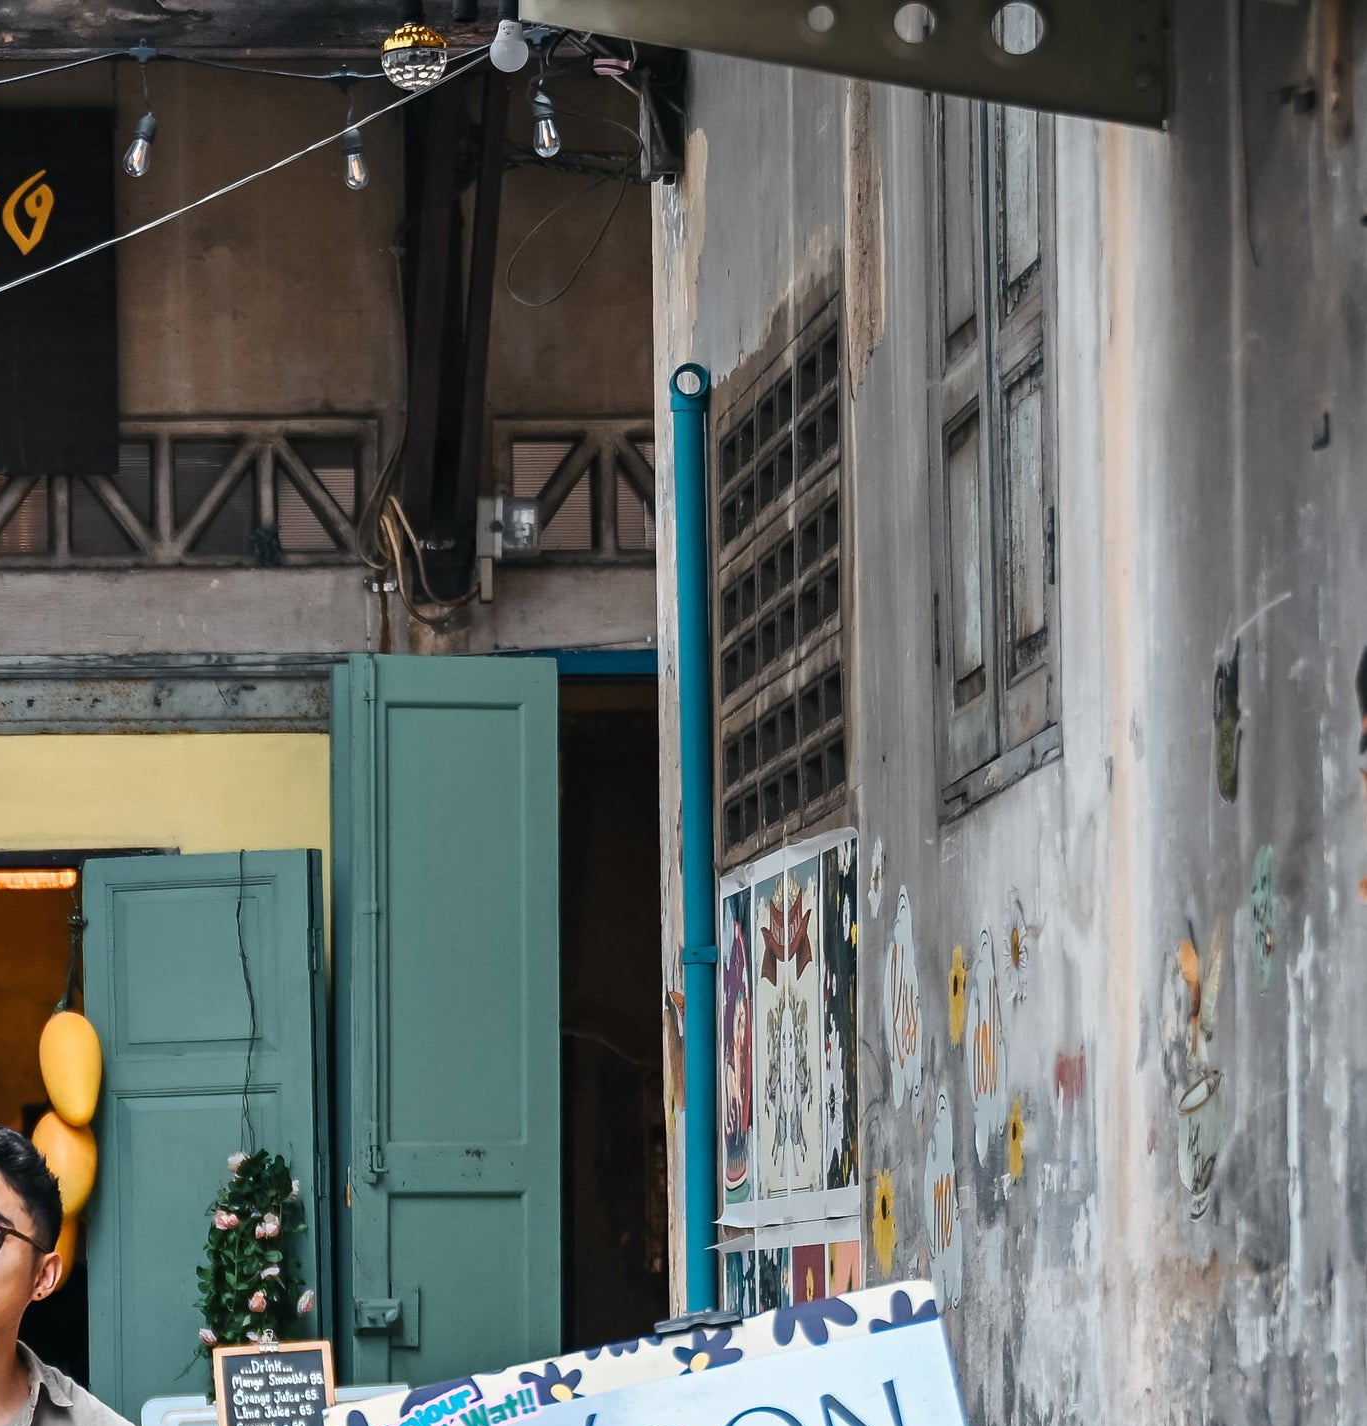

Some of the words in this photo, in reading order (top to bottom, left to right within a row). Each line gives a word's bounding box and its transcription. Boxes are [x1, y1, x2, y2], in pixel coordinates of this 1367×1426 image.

[932, 1172, 954, 1255] me
[972, 976, 998, 1102] doll
[231, 1375, 264, 1391] Mango
[268, 1372, 308, 1386] Smoothie
[233, 1388, 270, 1406] Orange
[234, 1406, 260, 1420] Lime
